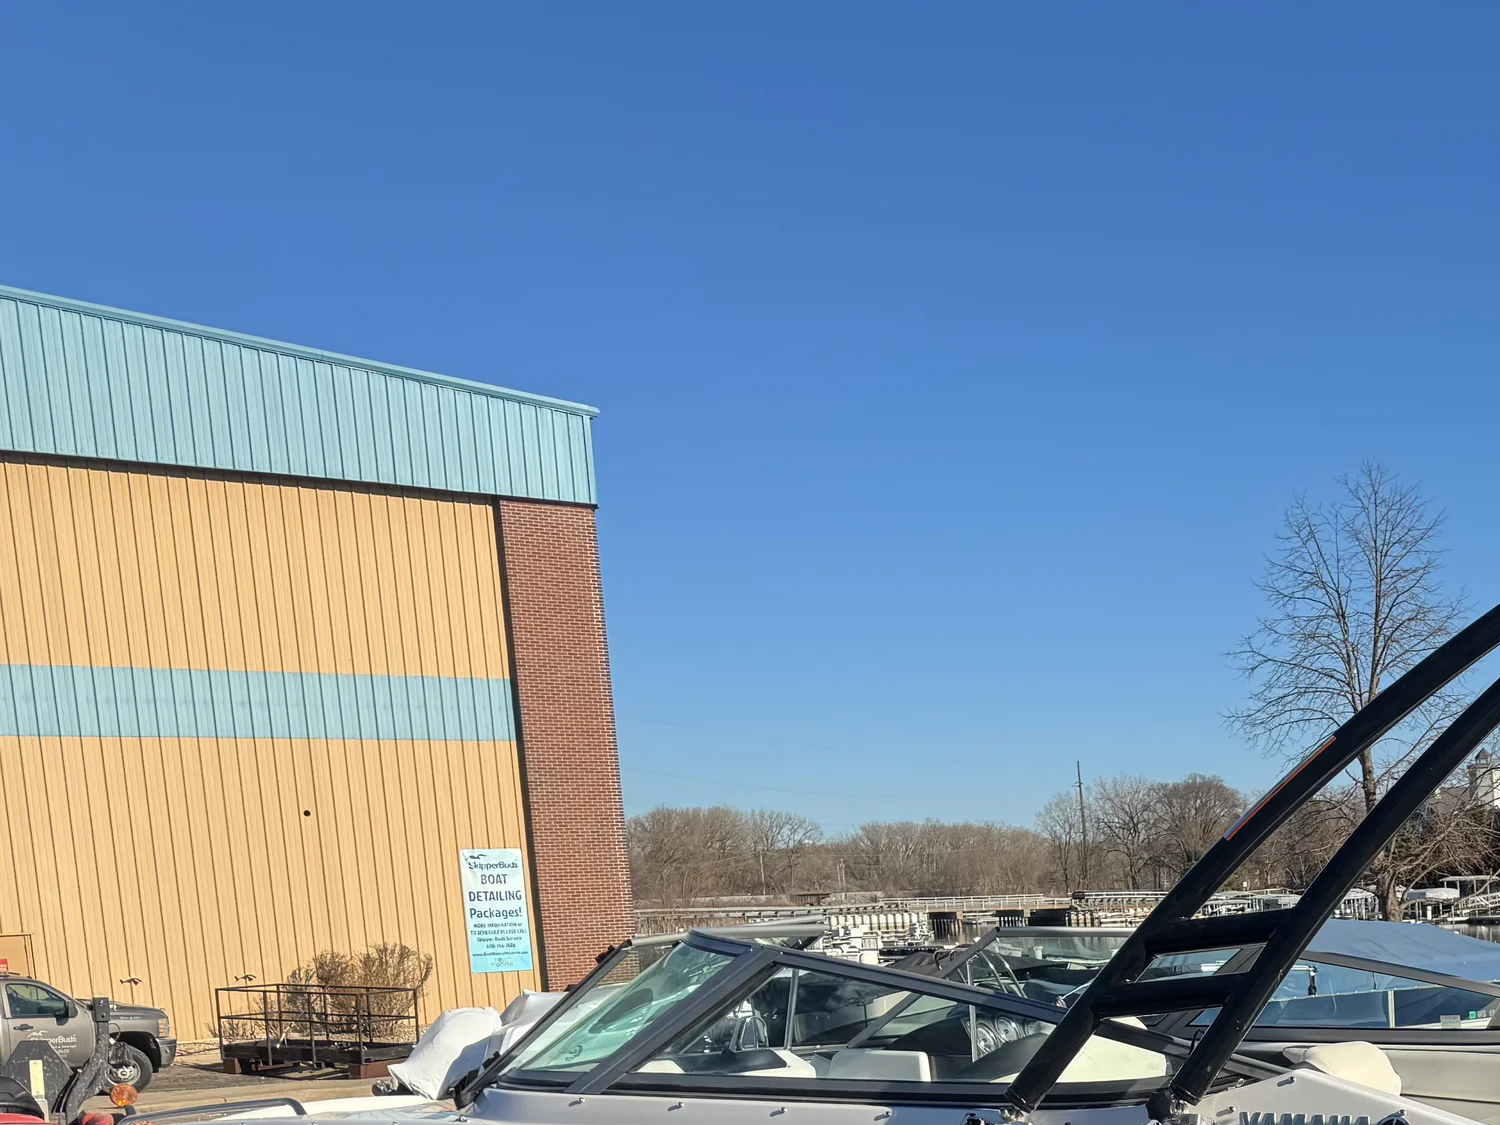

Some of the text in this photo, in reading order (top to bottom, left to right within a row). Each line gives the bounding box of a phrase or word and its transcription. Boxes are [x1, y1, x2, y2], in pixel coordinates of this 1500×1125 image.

[480, 873, 508, 885] BOAT
[468, 890, 522, 902] DETAILING
[469, 907, 523, 920] Packages!
